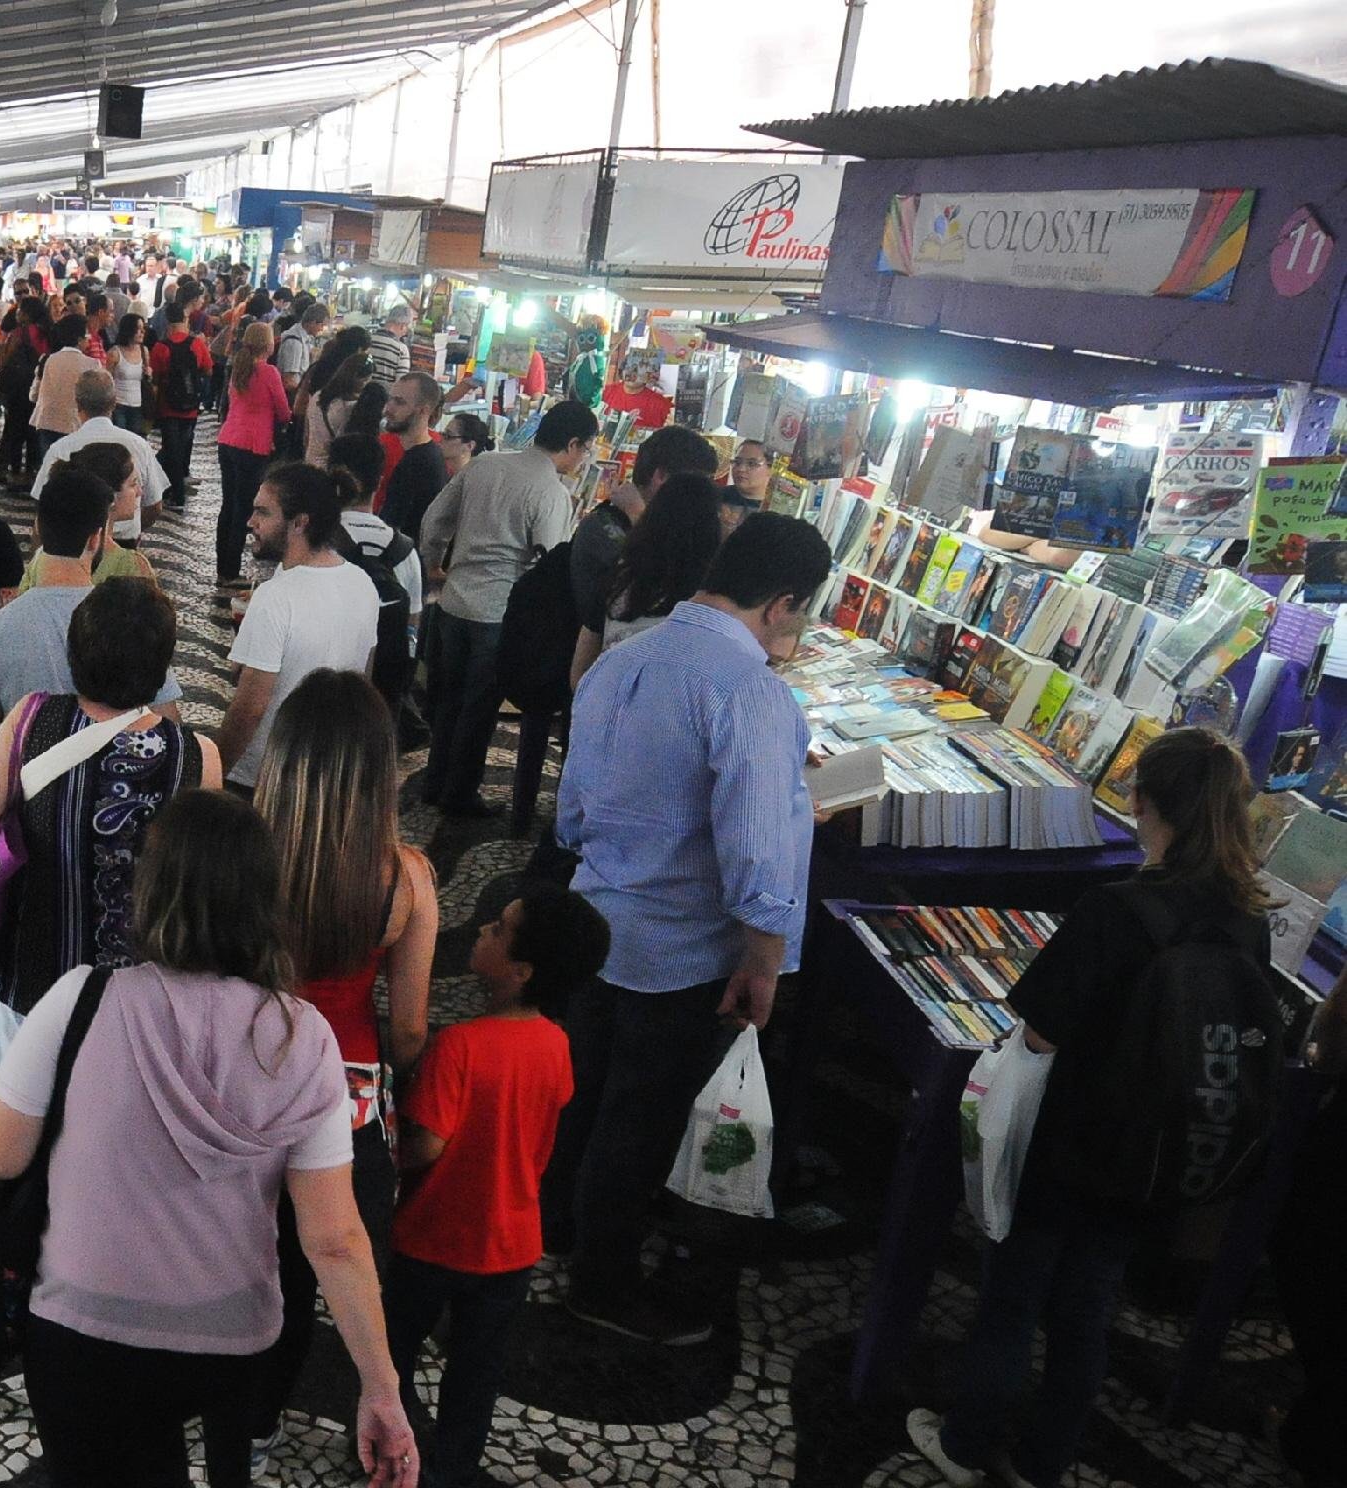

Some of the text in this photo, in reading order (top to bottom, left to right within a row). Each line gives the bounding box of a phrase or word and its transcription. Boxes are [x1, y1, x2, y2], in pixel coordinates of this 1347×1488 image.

[742, 207, 831, 261] Paulinas
[966, 208, 1117, 255] COLOSSAL
[1286, 222, 1327, 273] 11
[1164, 455, 1251, 472] CARROS
[1179, 1023, 1240, 1198] adidas
